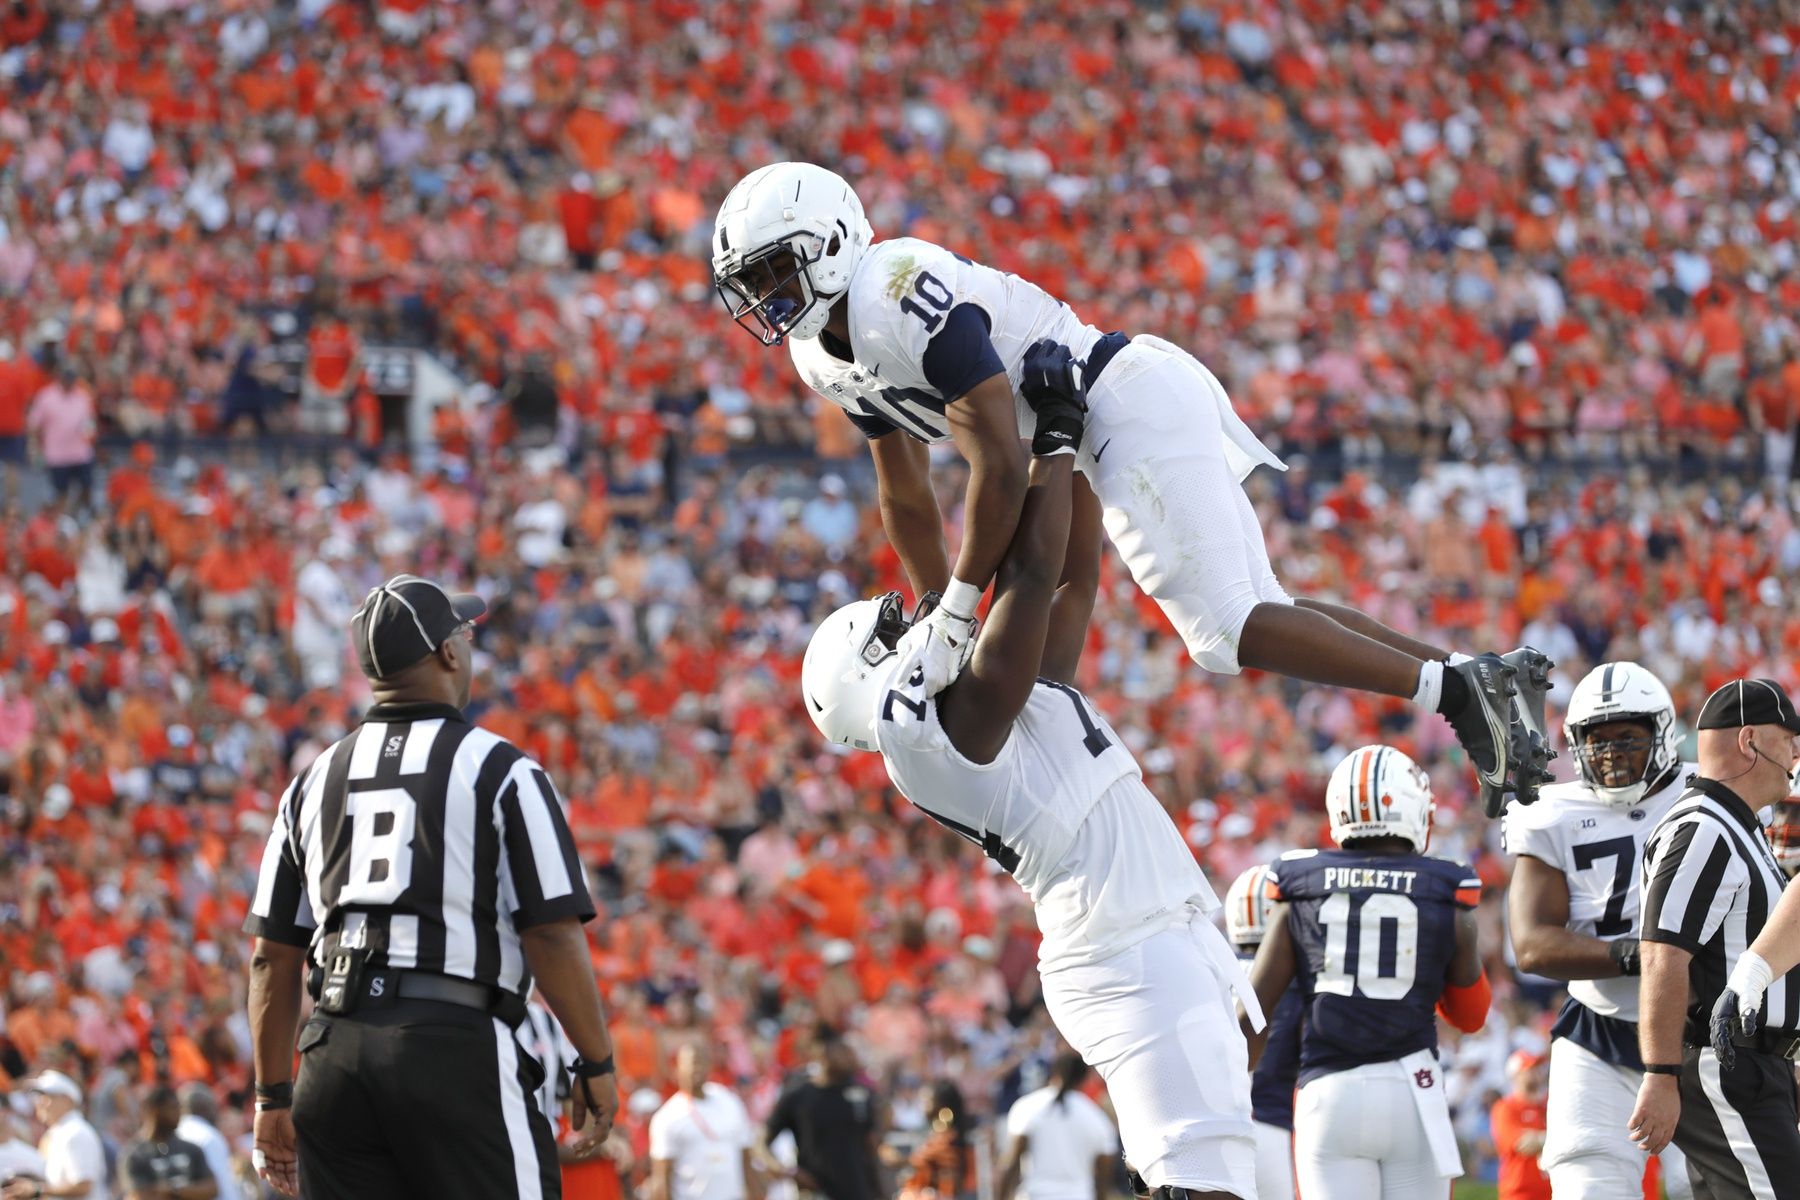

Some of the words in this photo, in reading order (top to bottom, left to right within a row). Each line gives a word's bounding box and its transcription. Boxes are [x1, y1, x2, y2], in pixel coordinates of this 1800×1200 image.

[900, 270, 954, 334] 10
[338, 787, 417, 907] B
[1323, 867, 1417, 894] PUCKETT
[1571, 835, 1636, 937] 7
[369, 977, 385, 997] S
[1313, 892, 1418, 1001] 10
